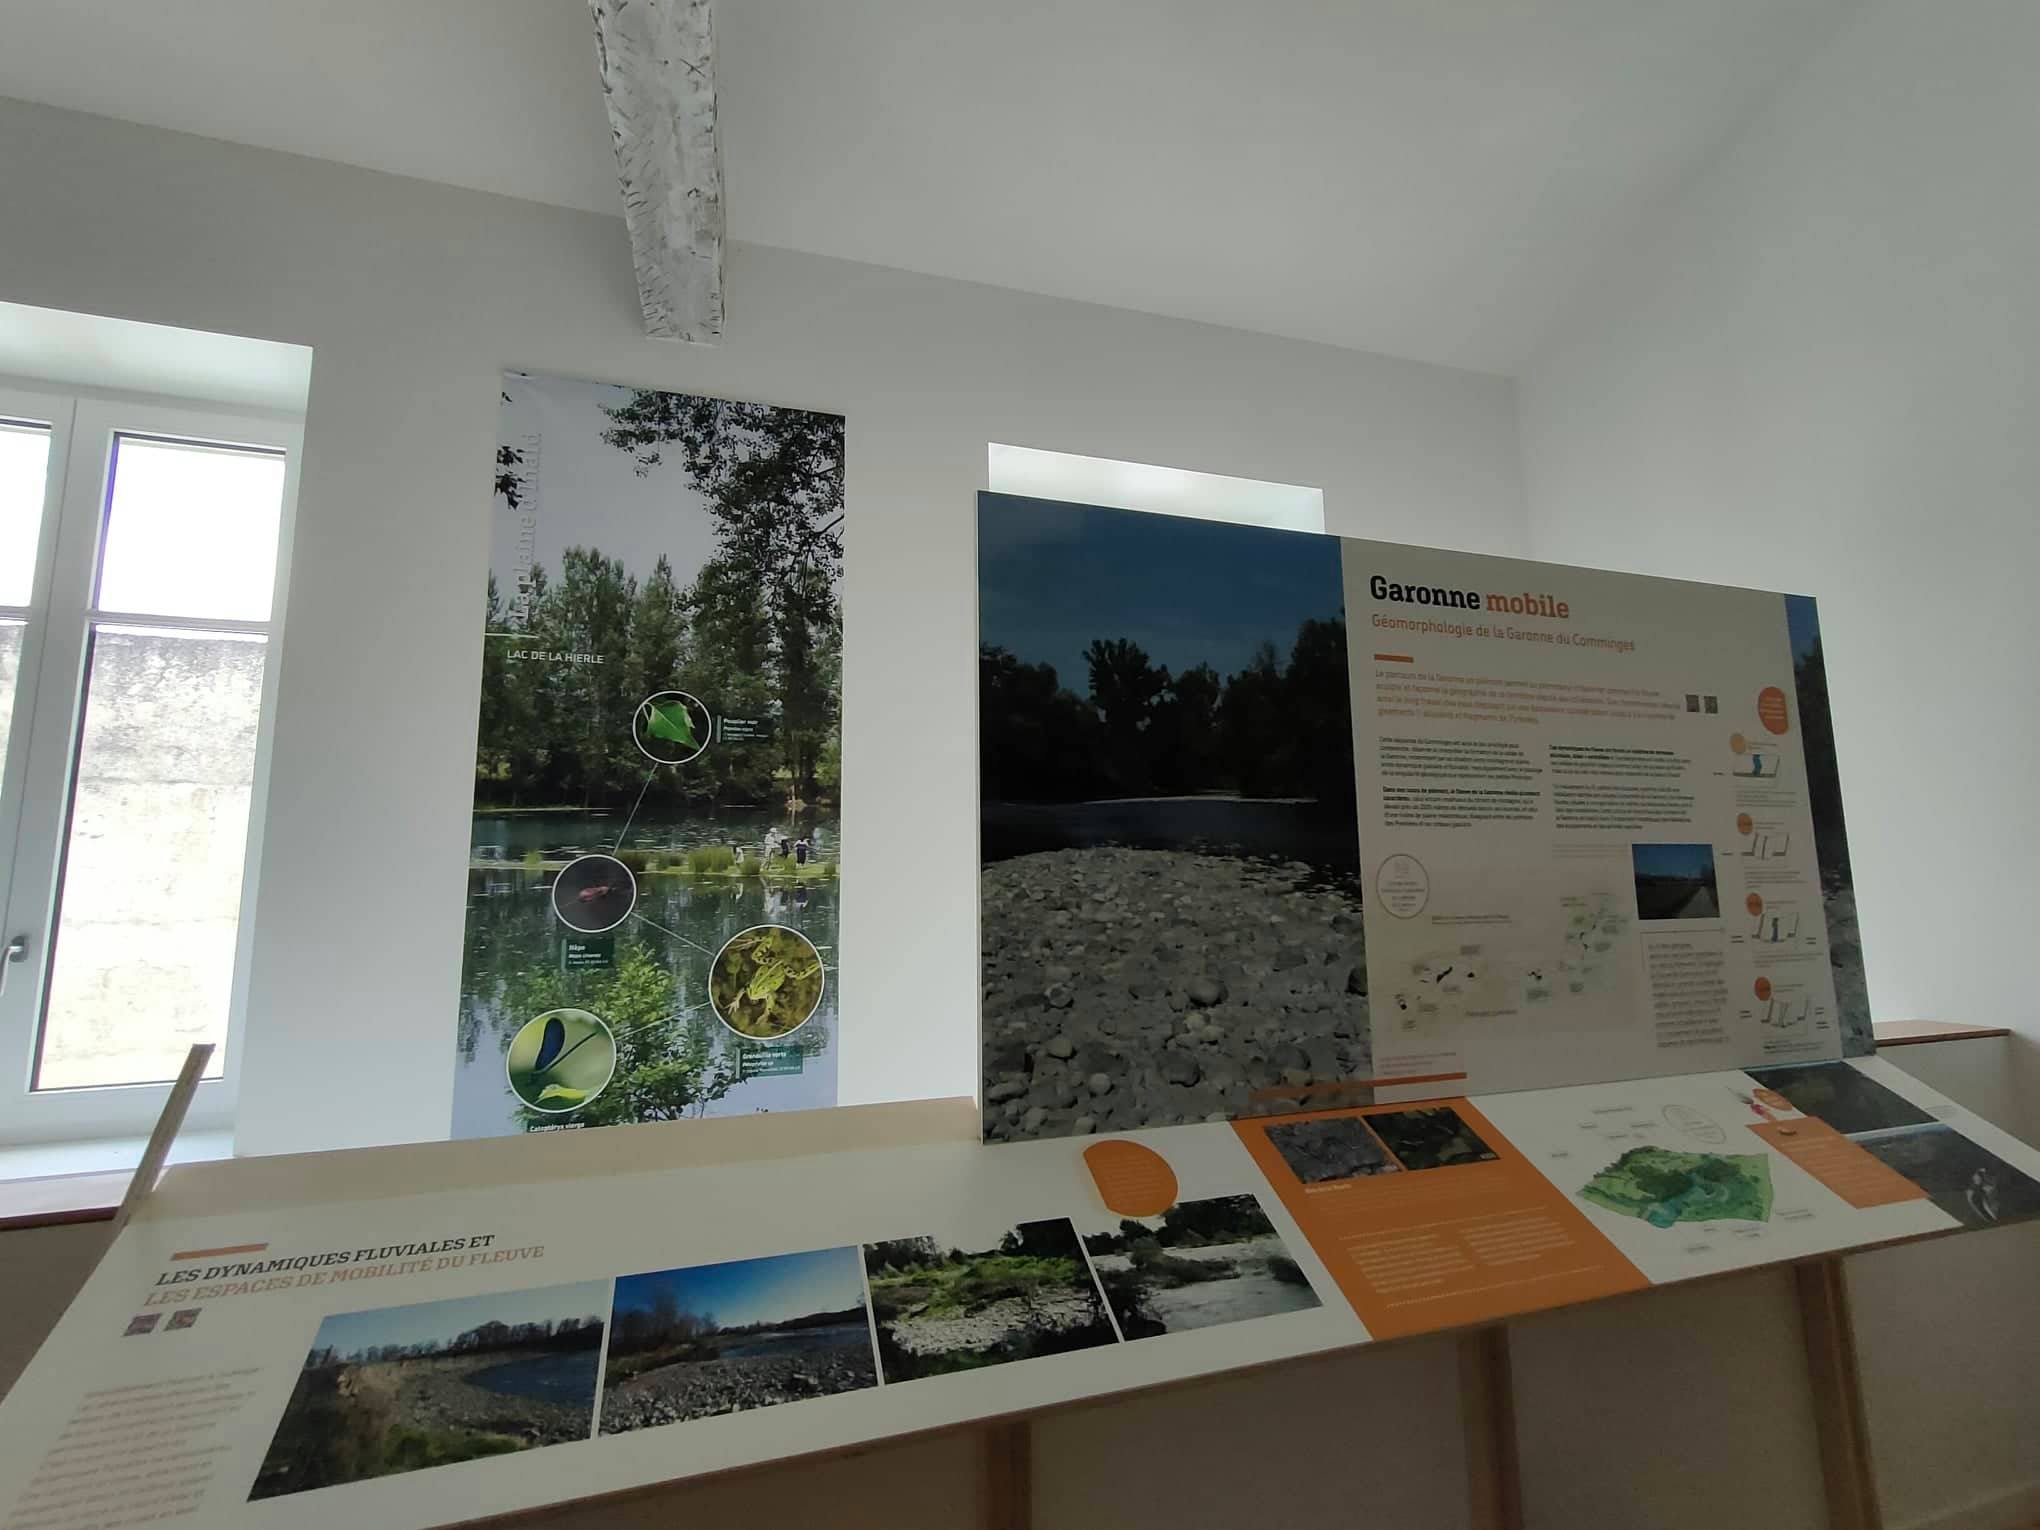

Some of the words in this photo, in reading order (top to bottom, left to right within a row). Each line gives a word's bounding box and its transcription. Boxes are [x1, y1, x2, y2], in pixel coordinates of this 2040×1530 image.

[1370, 574, 1480, 610] Garonne
[1485, 592, 1569, 619] mobile
[1372, 613, 1473, 638] Géomorphologie
[1476, 624, 1489, 637] de
[1493, 624, 1504, 639] la
[1506, 626, 1553, 643] Garonne
[1556, 630, 1570, 645] du
[1572, 632, 1635, 653] Comminges
[507, 649, 529, 660] LAC
[531, 650, 547, 661] DE
[549, 651, 563, 662] LA
[565, 653, 605, 664] HIERLE
[143, 1287, 191, 1306] LES
[192, 1275, 292, 1302] ESPACES
[295, 1272, 328, 1288] DE
[328, 1256, 434, 1283] MOBILITÉ
[435, 1254, 466, 1269] DU
[467, 1244, 545, 1266] FLEUVE
[155, 1270, 203, 1287] LES
[204, 1252, 352, 1281] DYNAMIQUES
[353, 1238, 466, 1264] FLUVIALES
[468, 1234, 496, 1248] ET
